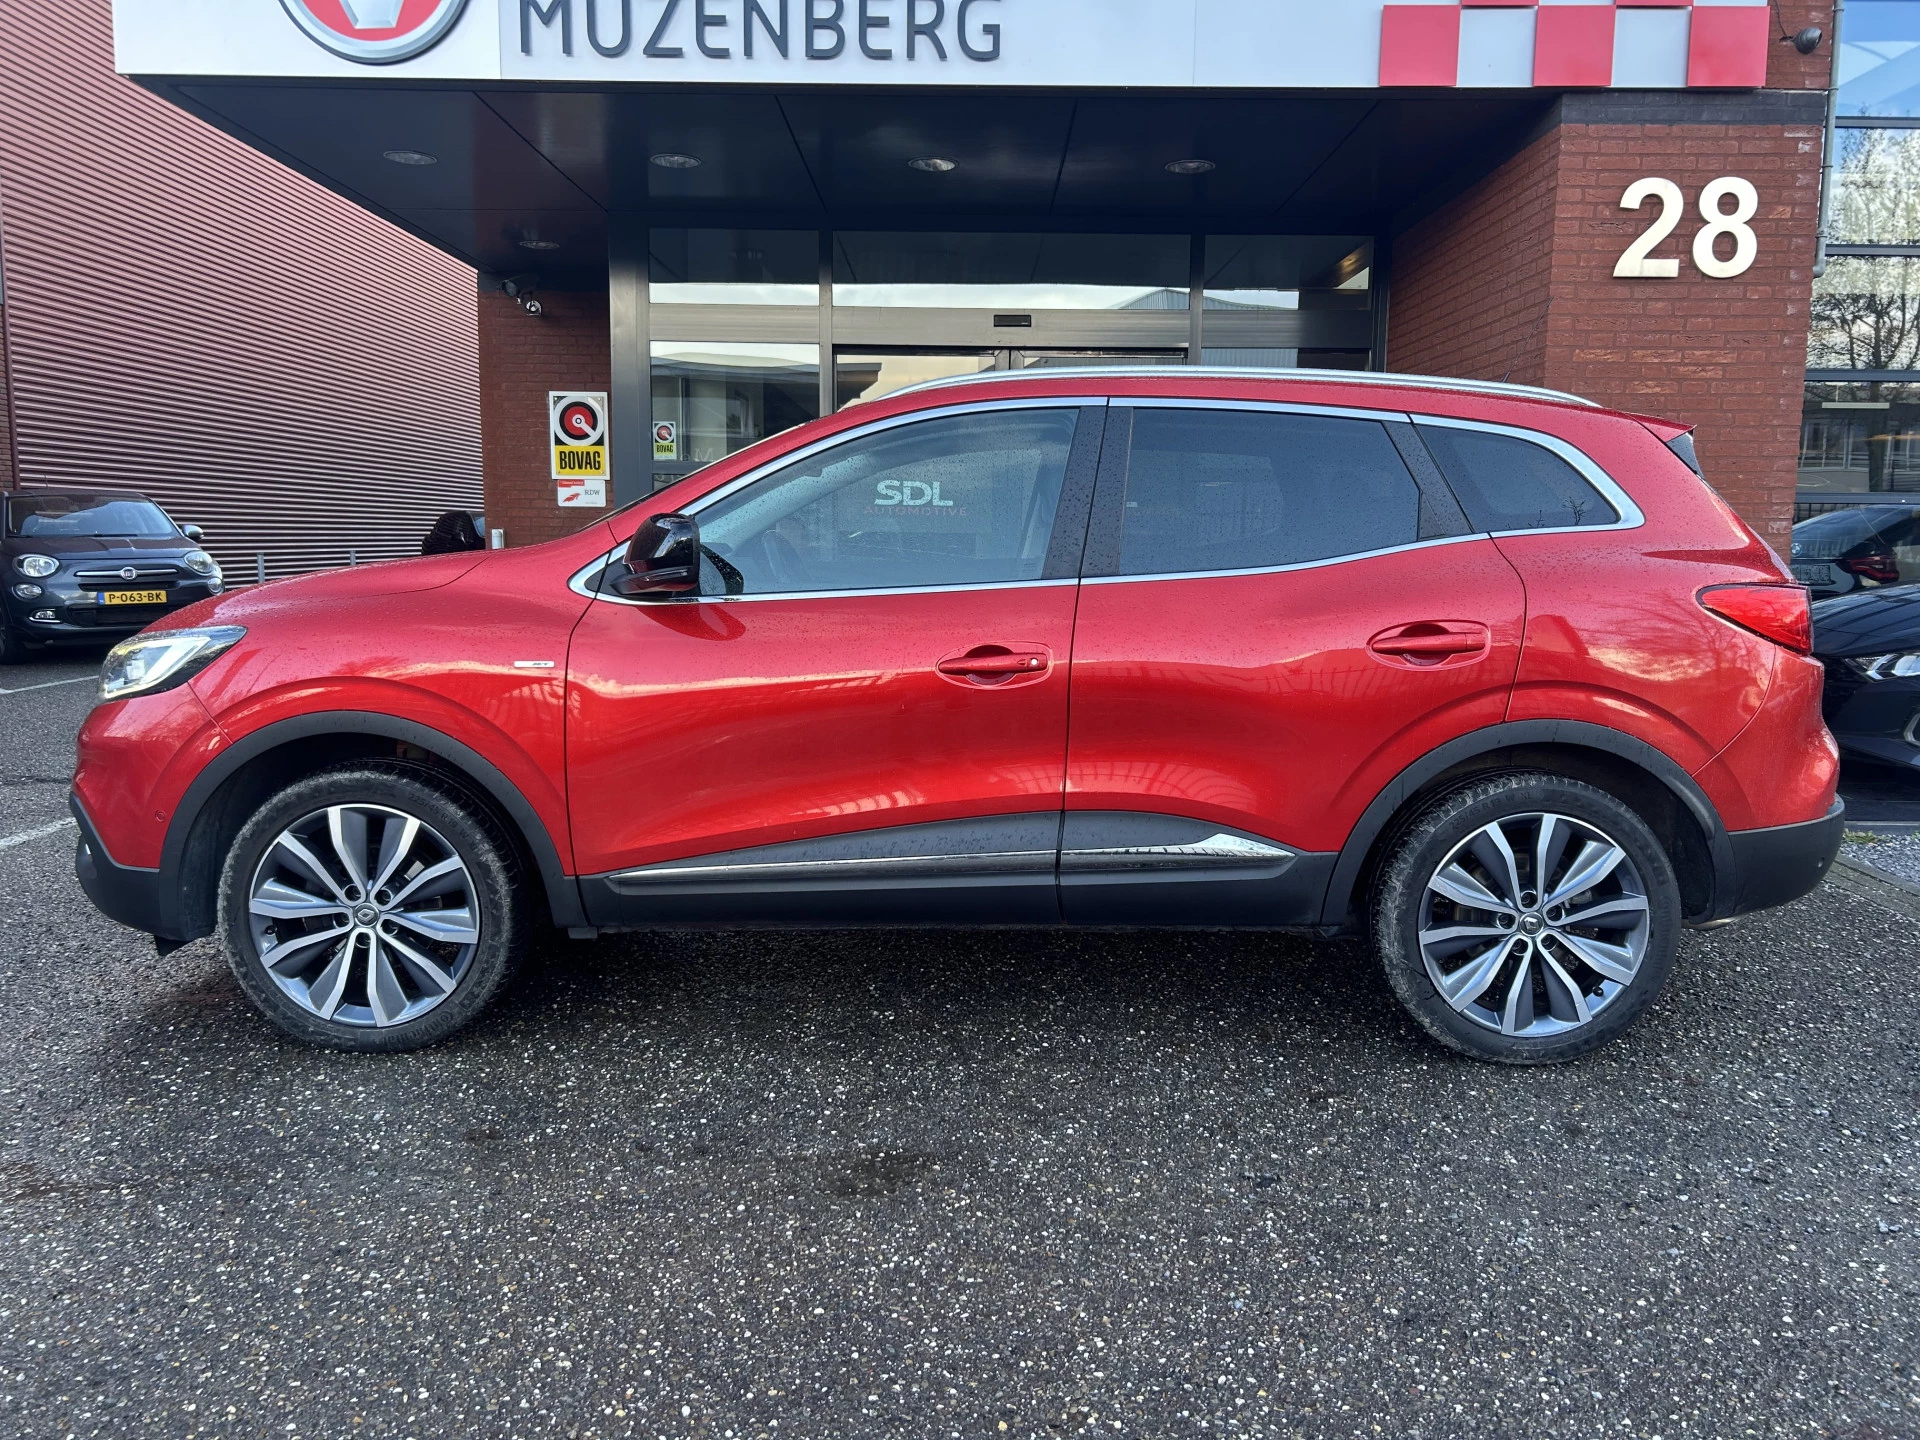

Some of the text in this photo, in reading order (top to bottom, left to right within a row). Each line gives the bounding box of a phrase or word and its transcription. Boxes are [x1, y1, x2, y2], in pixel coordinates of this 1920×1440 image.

[519, 0, 1001, 61] MUZENBERG
[1612, 176, 1758, 279] 28
[656, 444, 674, 453] BOVAG
[559, 450, 602, 470] BOVAG
[874, 479, 954, 507] SDL
[864, 505, 968, 517] AUTOMOTIVE
[108, 591, 163, 603] P-063-BK
